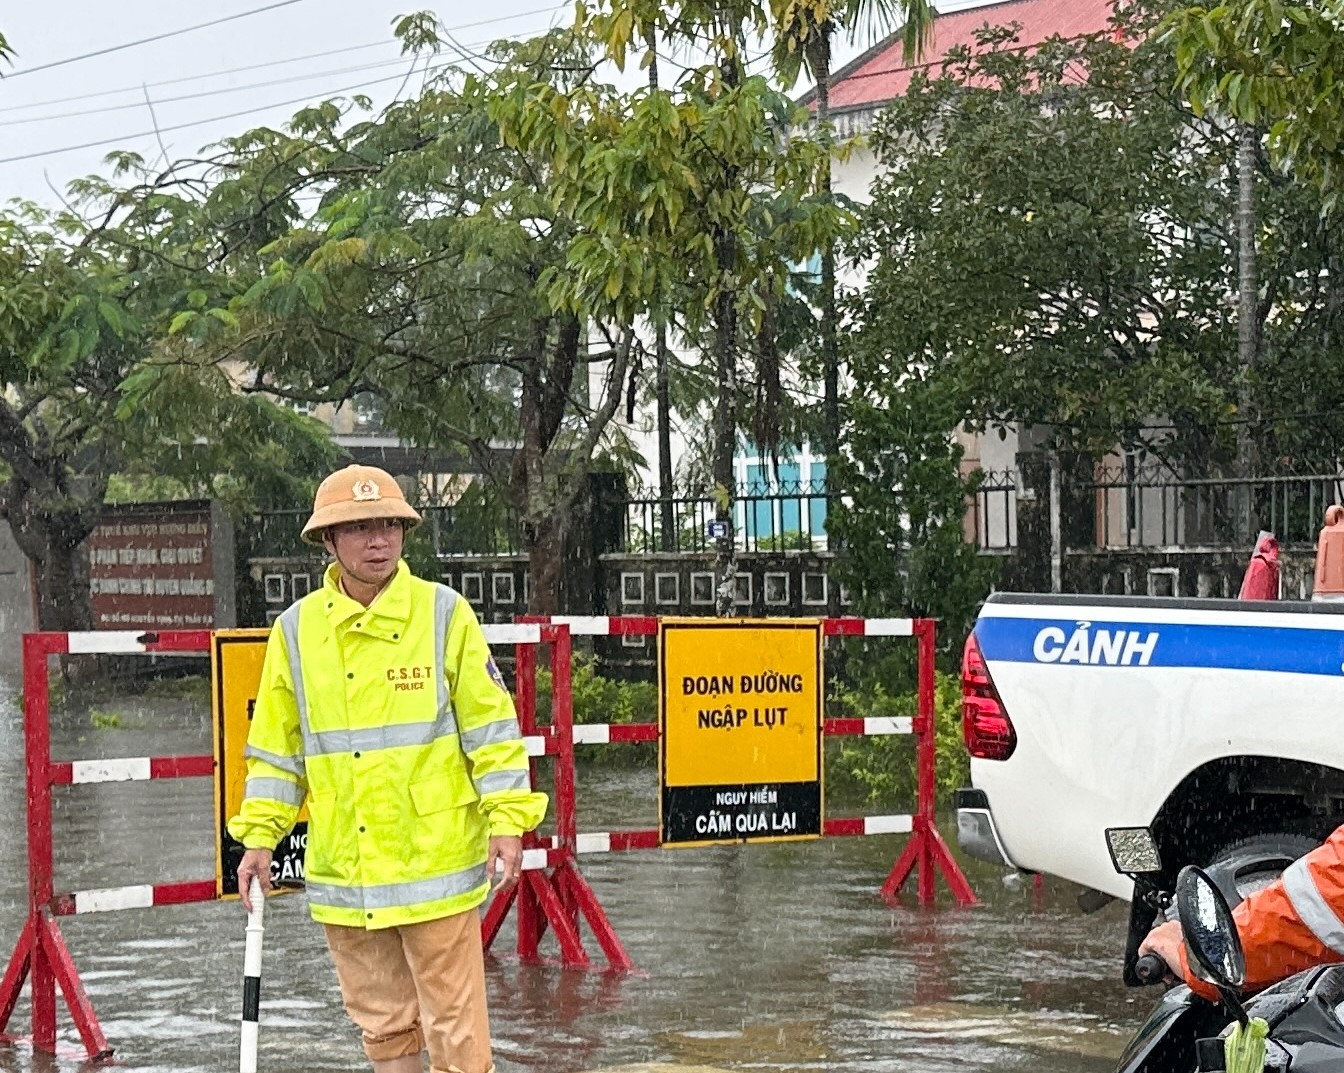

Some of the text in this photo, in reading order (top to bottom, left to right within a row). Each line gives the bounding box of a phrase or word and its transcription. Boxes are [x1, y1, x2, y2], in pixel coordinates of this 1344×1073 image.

[1033, 622, 1159, 666] CẢNH
[395, 682, 424, 691] POLICE
[682, 670, 803, 698] ĐOẠN ĐƯỜNG
[698, 704, 788, 731] NGẬP LỤT
[716, 791, 747, 805] NGUY
[696, 810, 796, 833] CẤM QUA LẠI
